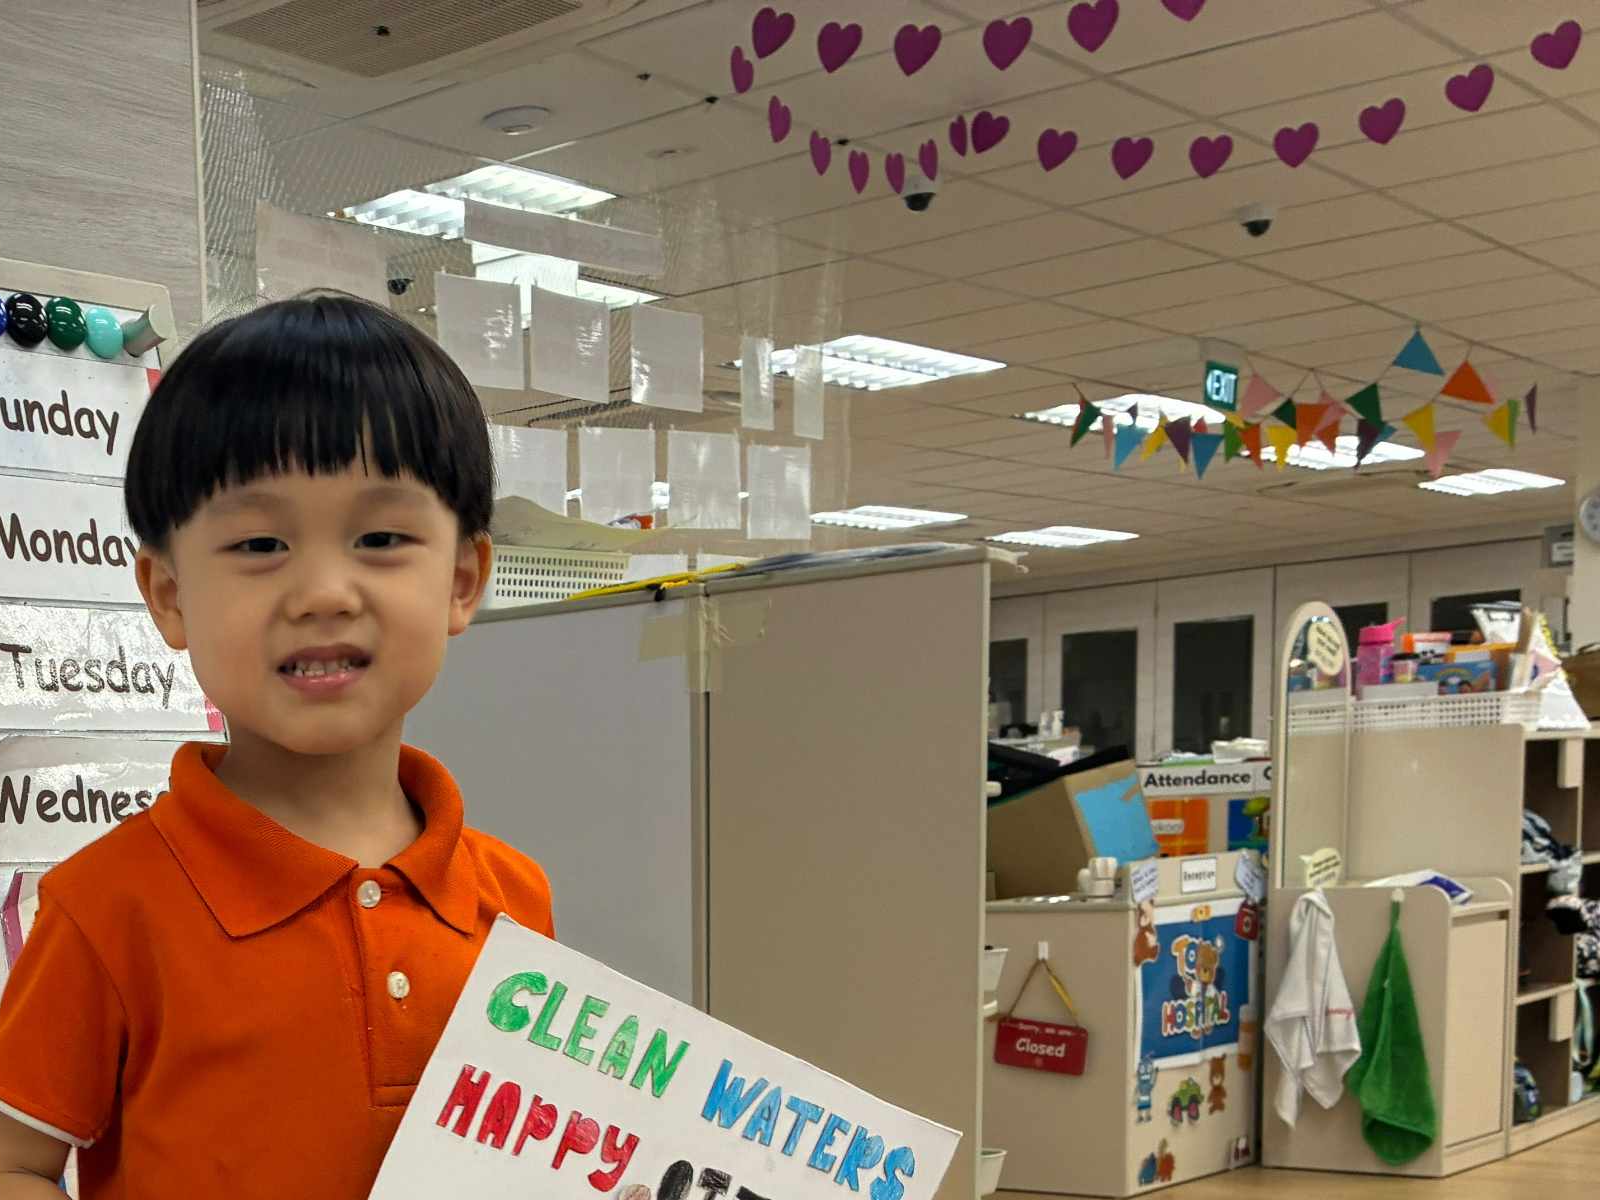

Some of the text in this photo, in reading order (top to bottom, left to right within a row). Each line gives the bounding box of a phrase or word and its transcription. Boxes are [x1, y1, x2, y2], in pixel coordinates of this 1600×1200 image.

[1143, 769, 1253, 789] Attendance
[486, 970, 690, 1099] CLEAN
[1015, 1037, 1067, 1058] Closed
